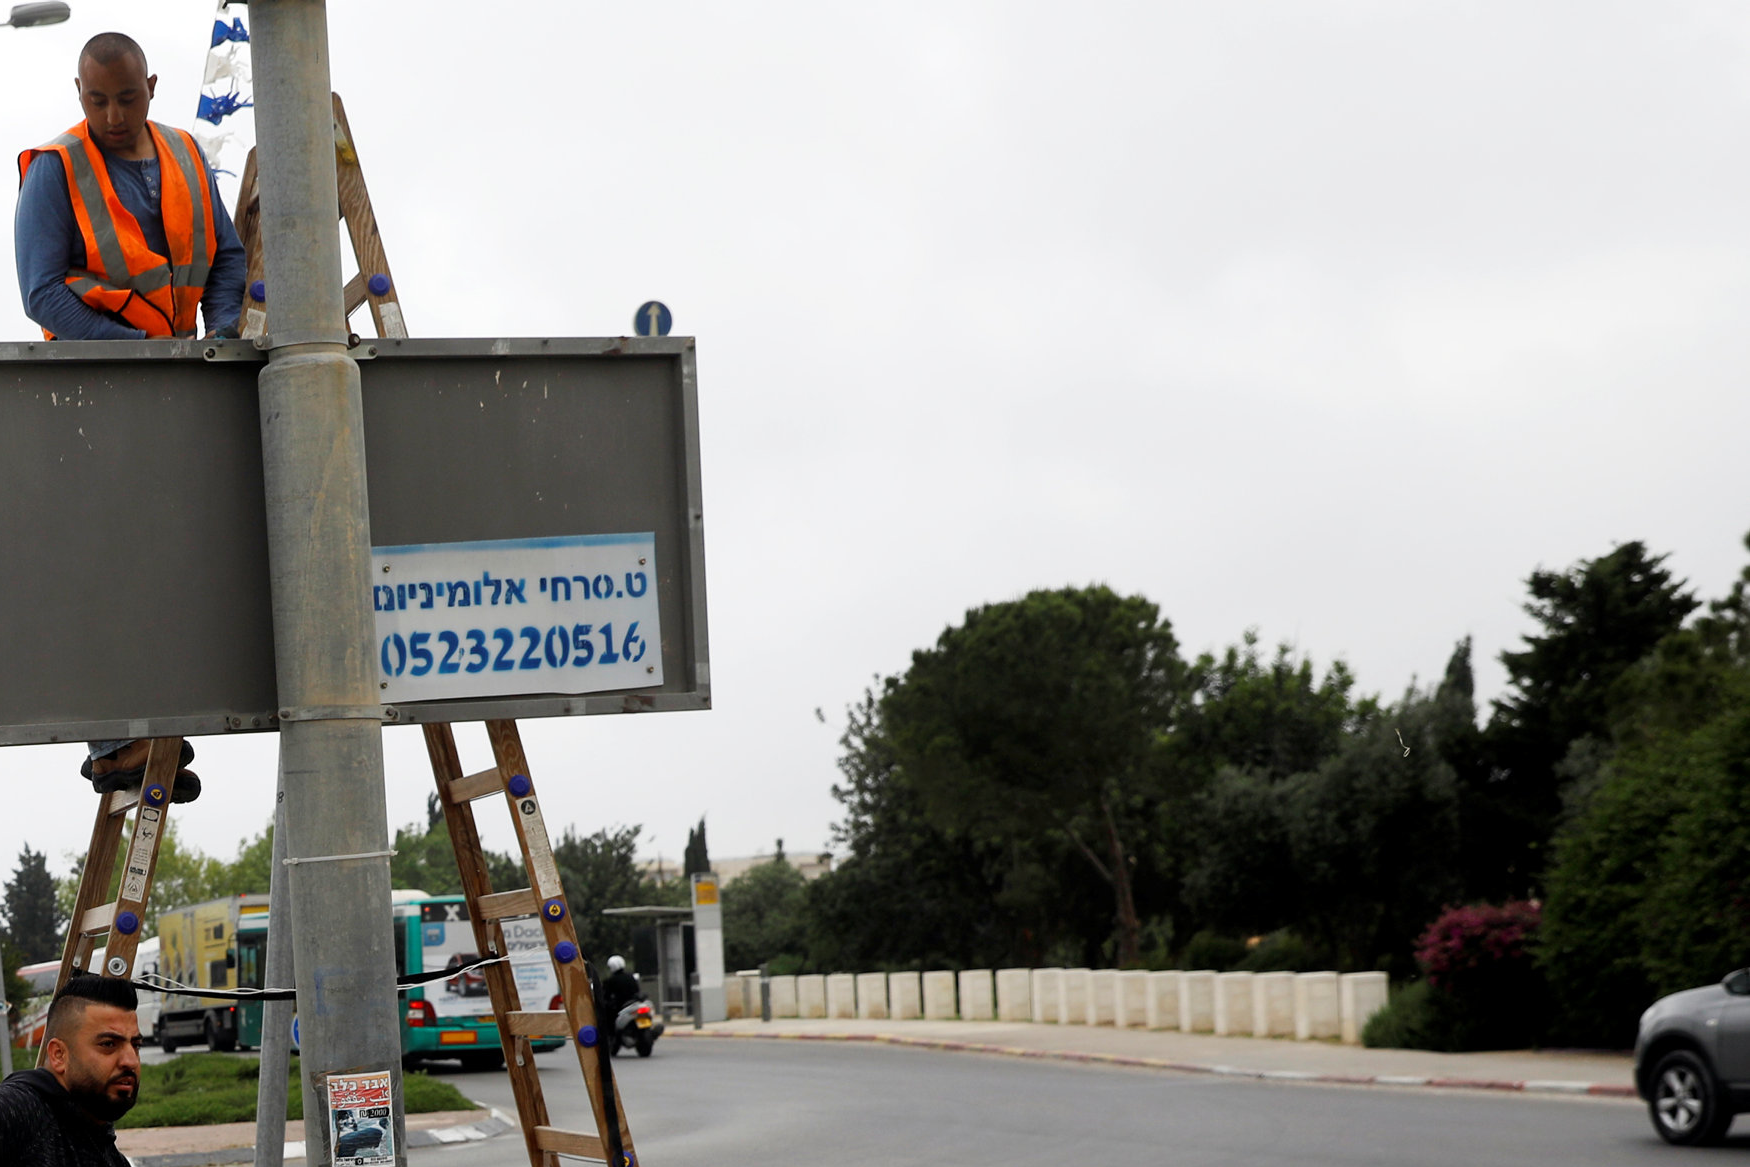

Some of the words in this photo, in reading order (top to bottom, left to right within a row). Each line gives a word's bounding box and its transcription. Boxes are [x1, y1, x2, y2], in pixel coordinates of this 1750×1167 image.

[373, 571, 528, 612] אלומיניום
[381, 621, 647, 678] 0523220516
[330, 1079, 357, 1092] כלב
[362, 1078, 388, 1090] אבד
